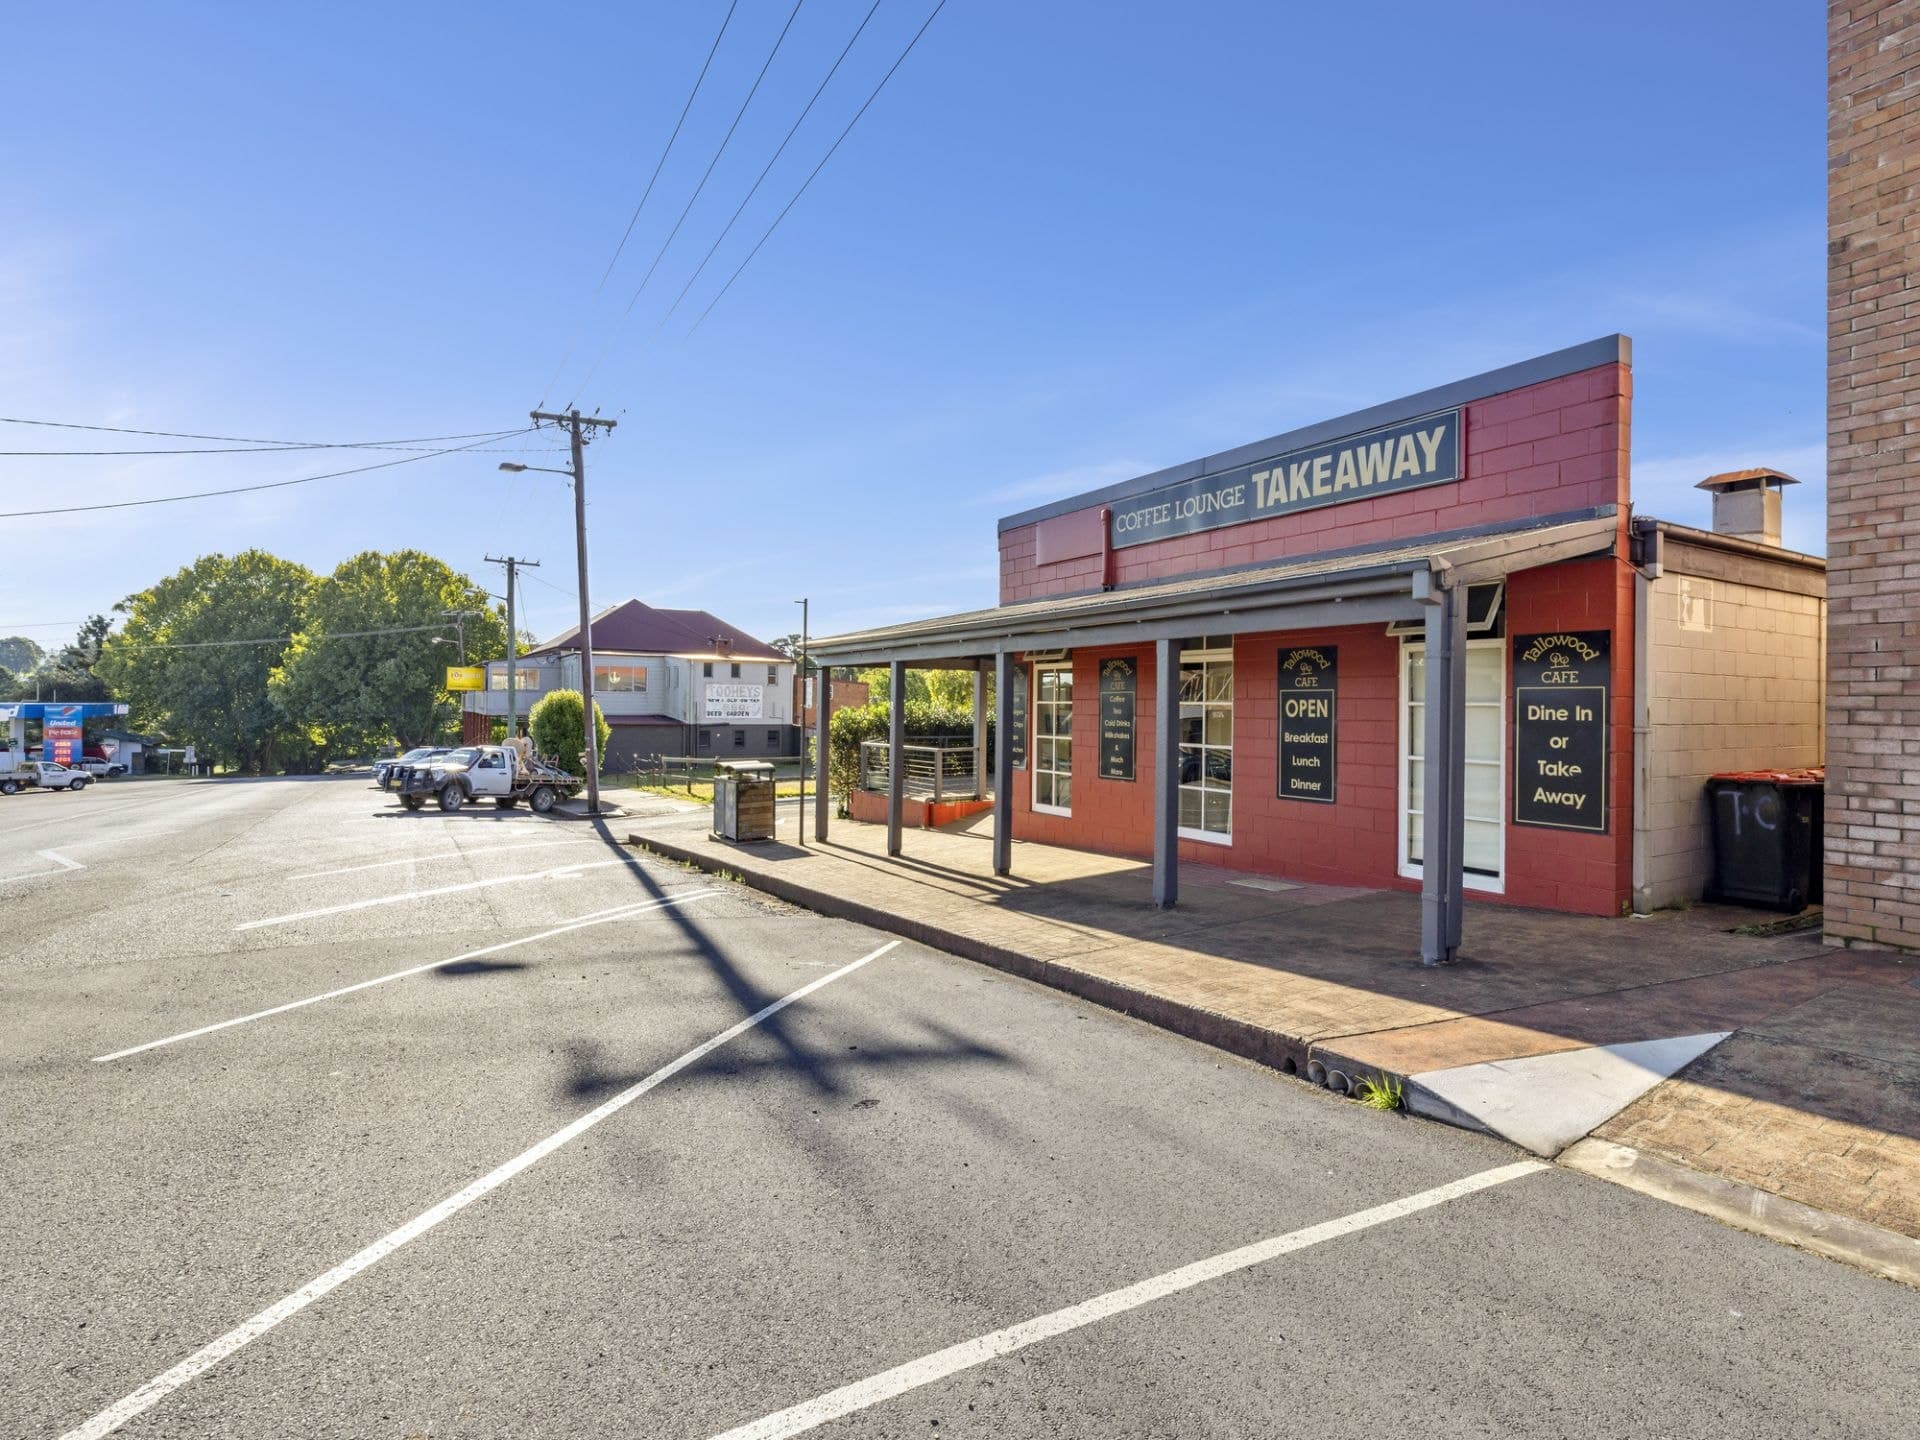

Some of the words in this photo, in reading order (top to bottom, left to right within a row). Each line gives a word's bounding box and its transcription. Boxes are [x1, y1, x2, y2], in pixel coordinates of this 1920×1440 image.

[1116, 503, 1171, 533] COFFEE
[1175, 485, 1245, 520] LOUNGE
[1252, 425, 1446, 509] TAKEAWAY
[1522, 635, 1600, 662] Tallowood
[1283, 649, 1331, 670] Tallowood
[1295, 676, 1318, 687] CAFE
[1541, 671, 1579, 684] CAFE
[707, 686, 761, 698] TOOHEYS
[1285, 699, 1329, 718] OPEN
[1527, 705, 1569, 721] Dine
[1576, 705, 1593, 722] In
[1104, 719, 1115, 727] Cold
[1116, 719, 1131, 727] Drinks
[1284, 732, 1329, 744] Breakfast
[1549, 736, 1569, 749] or
[1292, 755, 1321, 767] Lunch
[1537, 760, 1582, 777] Take
[1290, 778, 1322, 791] Dinner
[1533, 787, 1586, 810] Away
